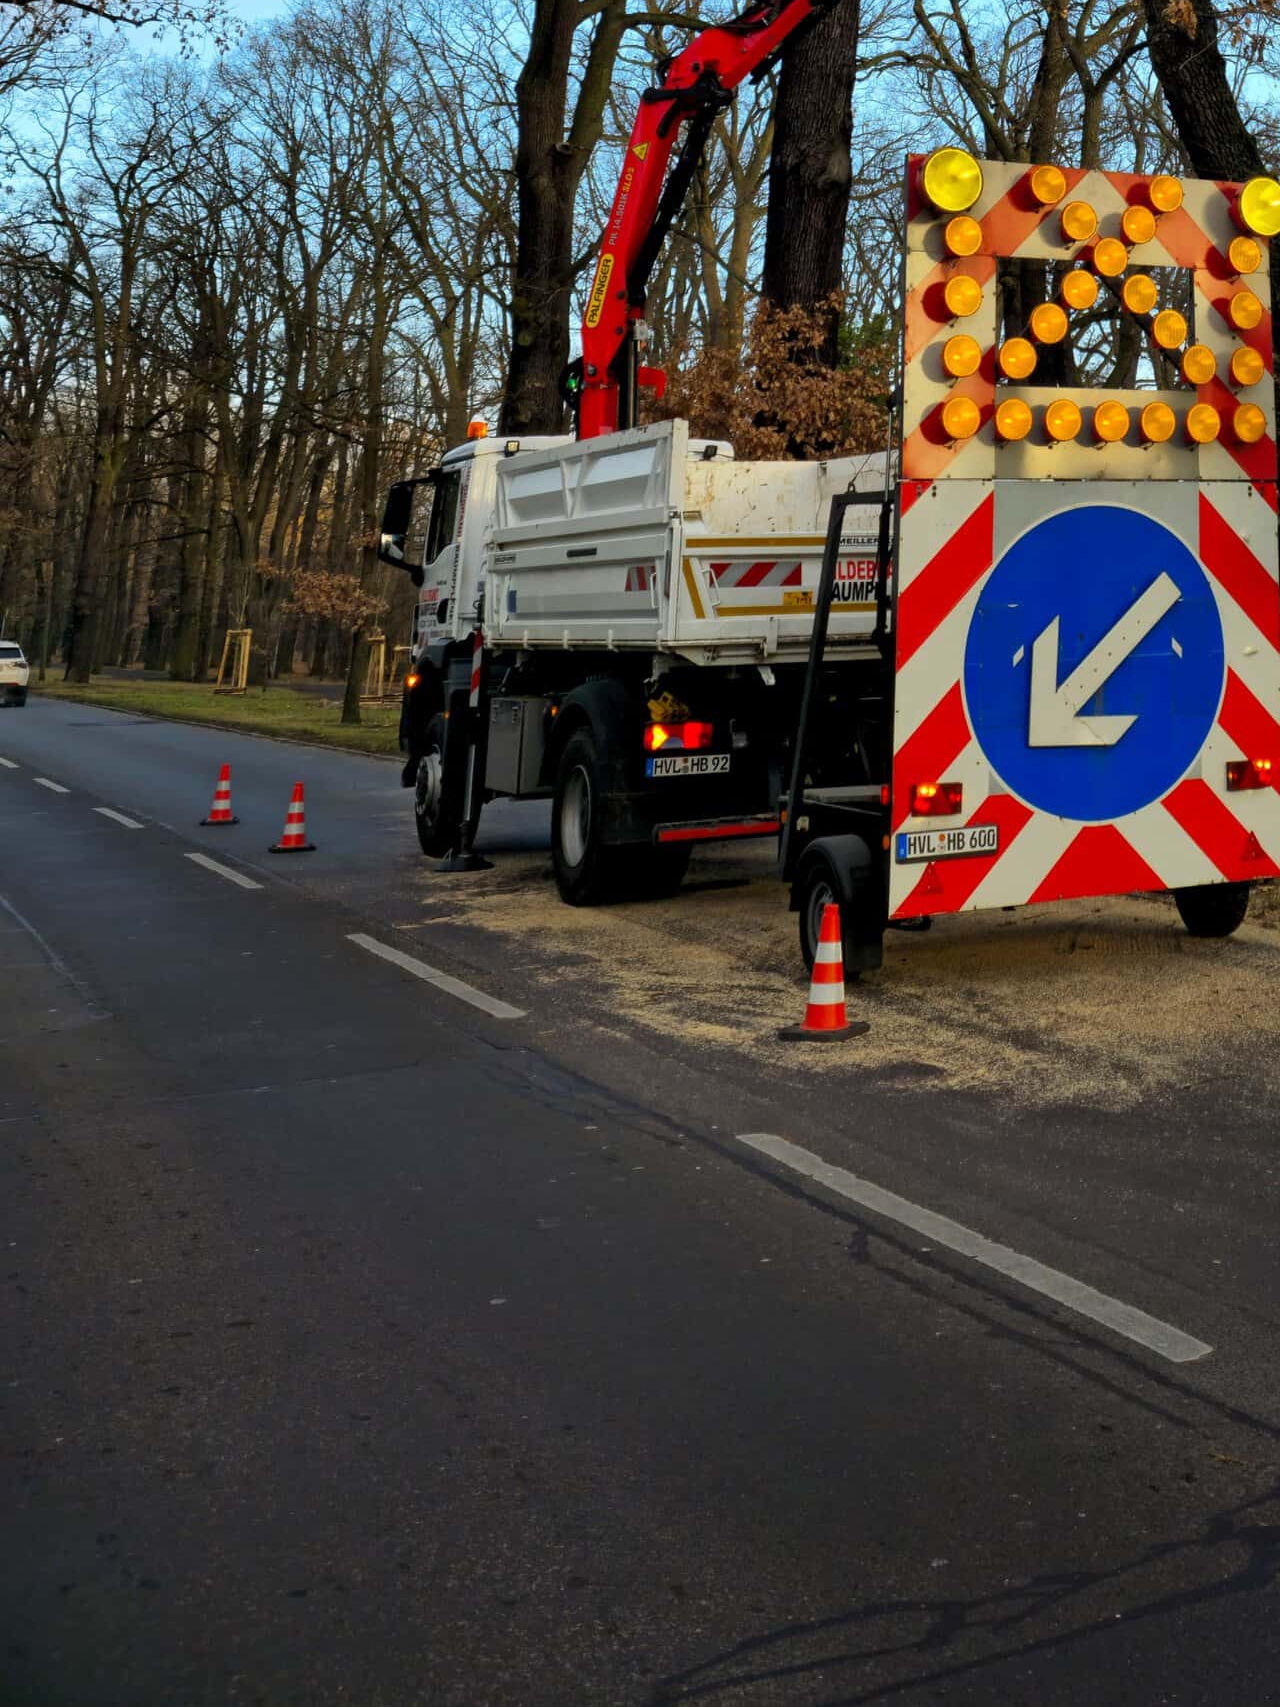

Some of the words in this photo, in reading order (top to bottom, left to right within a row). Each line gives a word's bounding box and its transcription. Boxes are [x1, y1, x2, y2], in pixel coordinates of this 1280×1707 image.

[588, 258, 612, 324] PALFINGER
[654, 759, 681, 774] HVL
[691, 757, 708, 772] HB
[711, 756, 728, 771] 92
[908, 835, 936, 854] HVL
[947, 833, 965, 851] HB
[969, 829, 995, 848] 600
